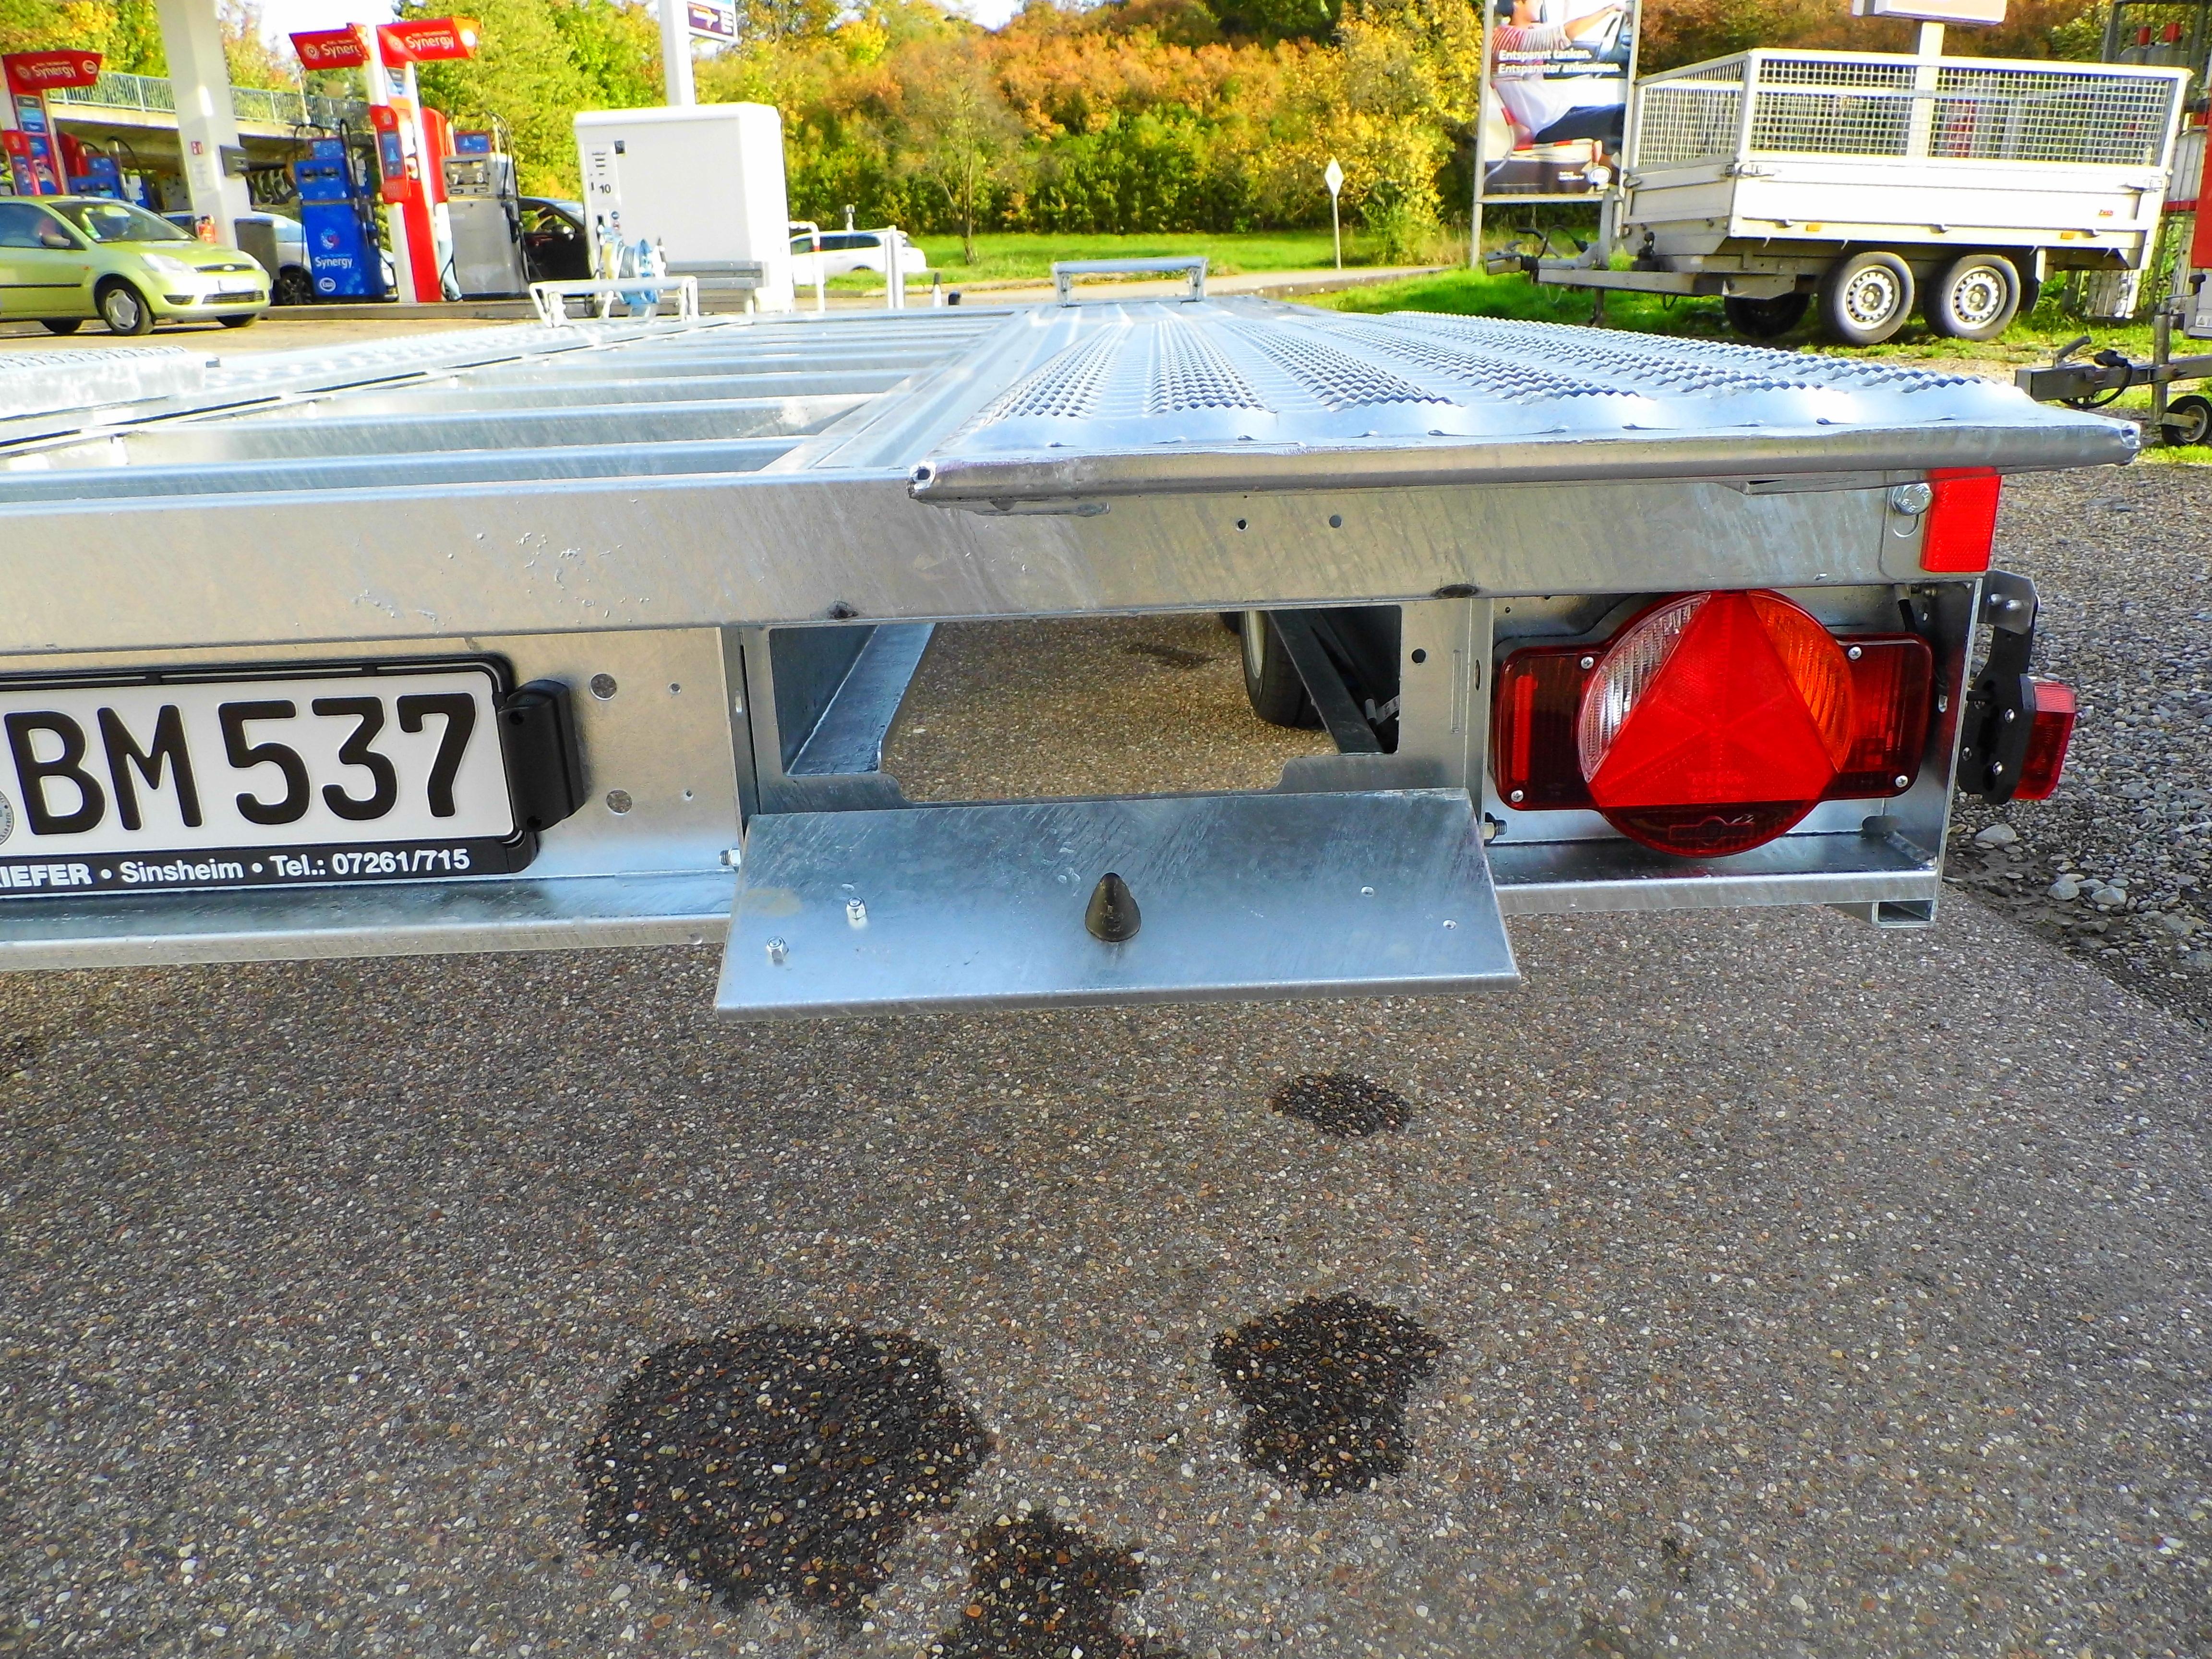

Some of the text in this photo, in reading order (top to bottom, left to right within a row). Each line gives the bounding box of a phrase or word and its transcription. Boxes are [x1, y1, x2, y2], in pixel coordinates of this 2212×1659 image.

[405, 36, 455, 51] Synergy
[1499, 48, 1592, 62] Entspannt tanken.
[31, 65, 76, 79] Synergy
[1498, 61, 1622, 76] Entspannter ankommen.
[453, 174, 459, 184] 7
[477, 172, 484, 183] 8
[600, 184, 611, 193] 10
[315, 256, 353, 269] Synergy
[4, 692, 477, 835] BM 537
[0, 848, 470, 888] IEFER Sinsheim Tel.: 07261/715
